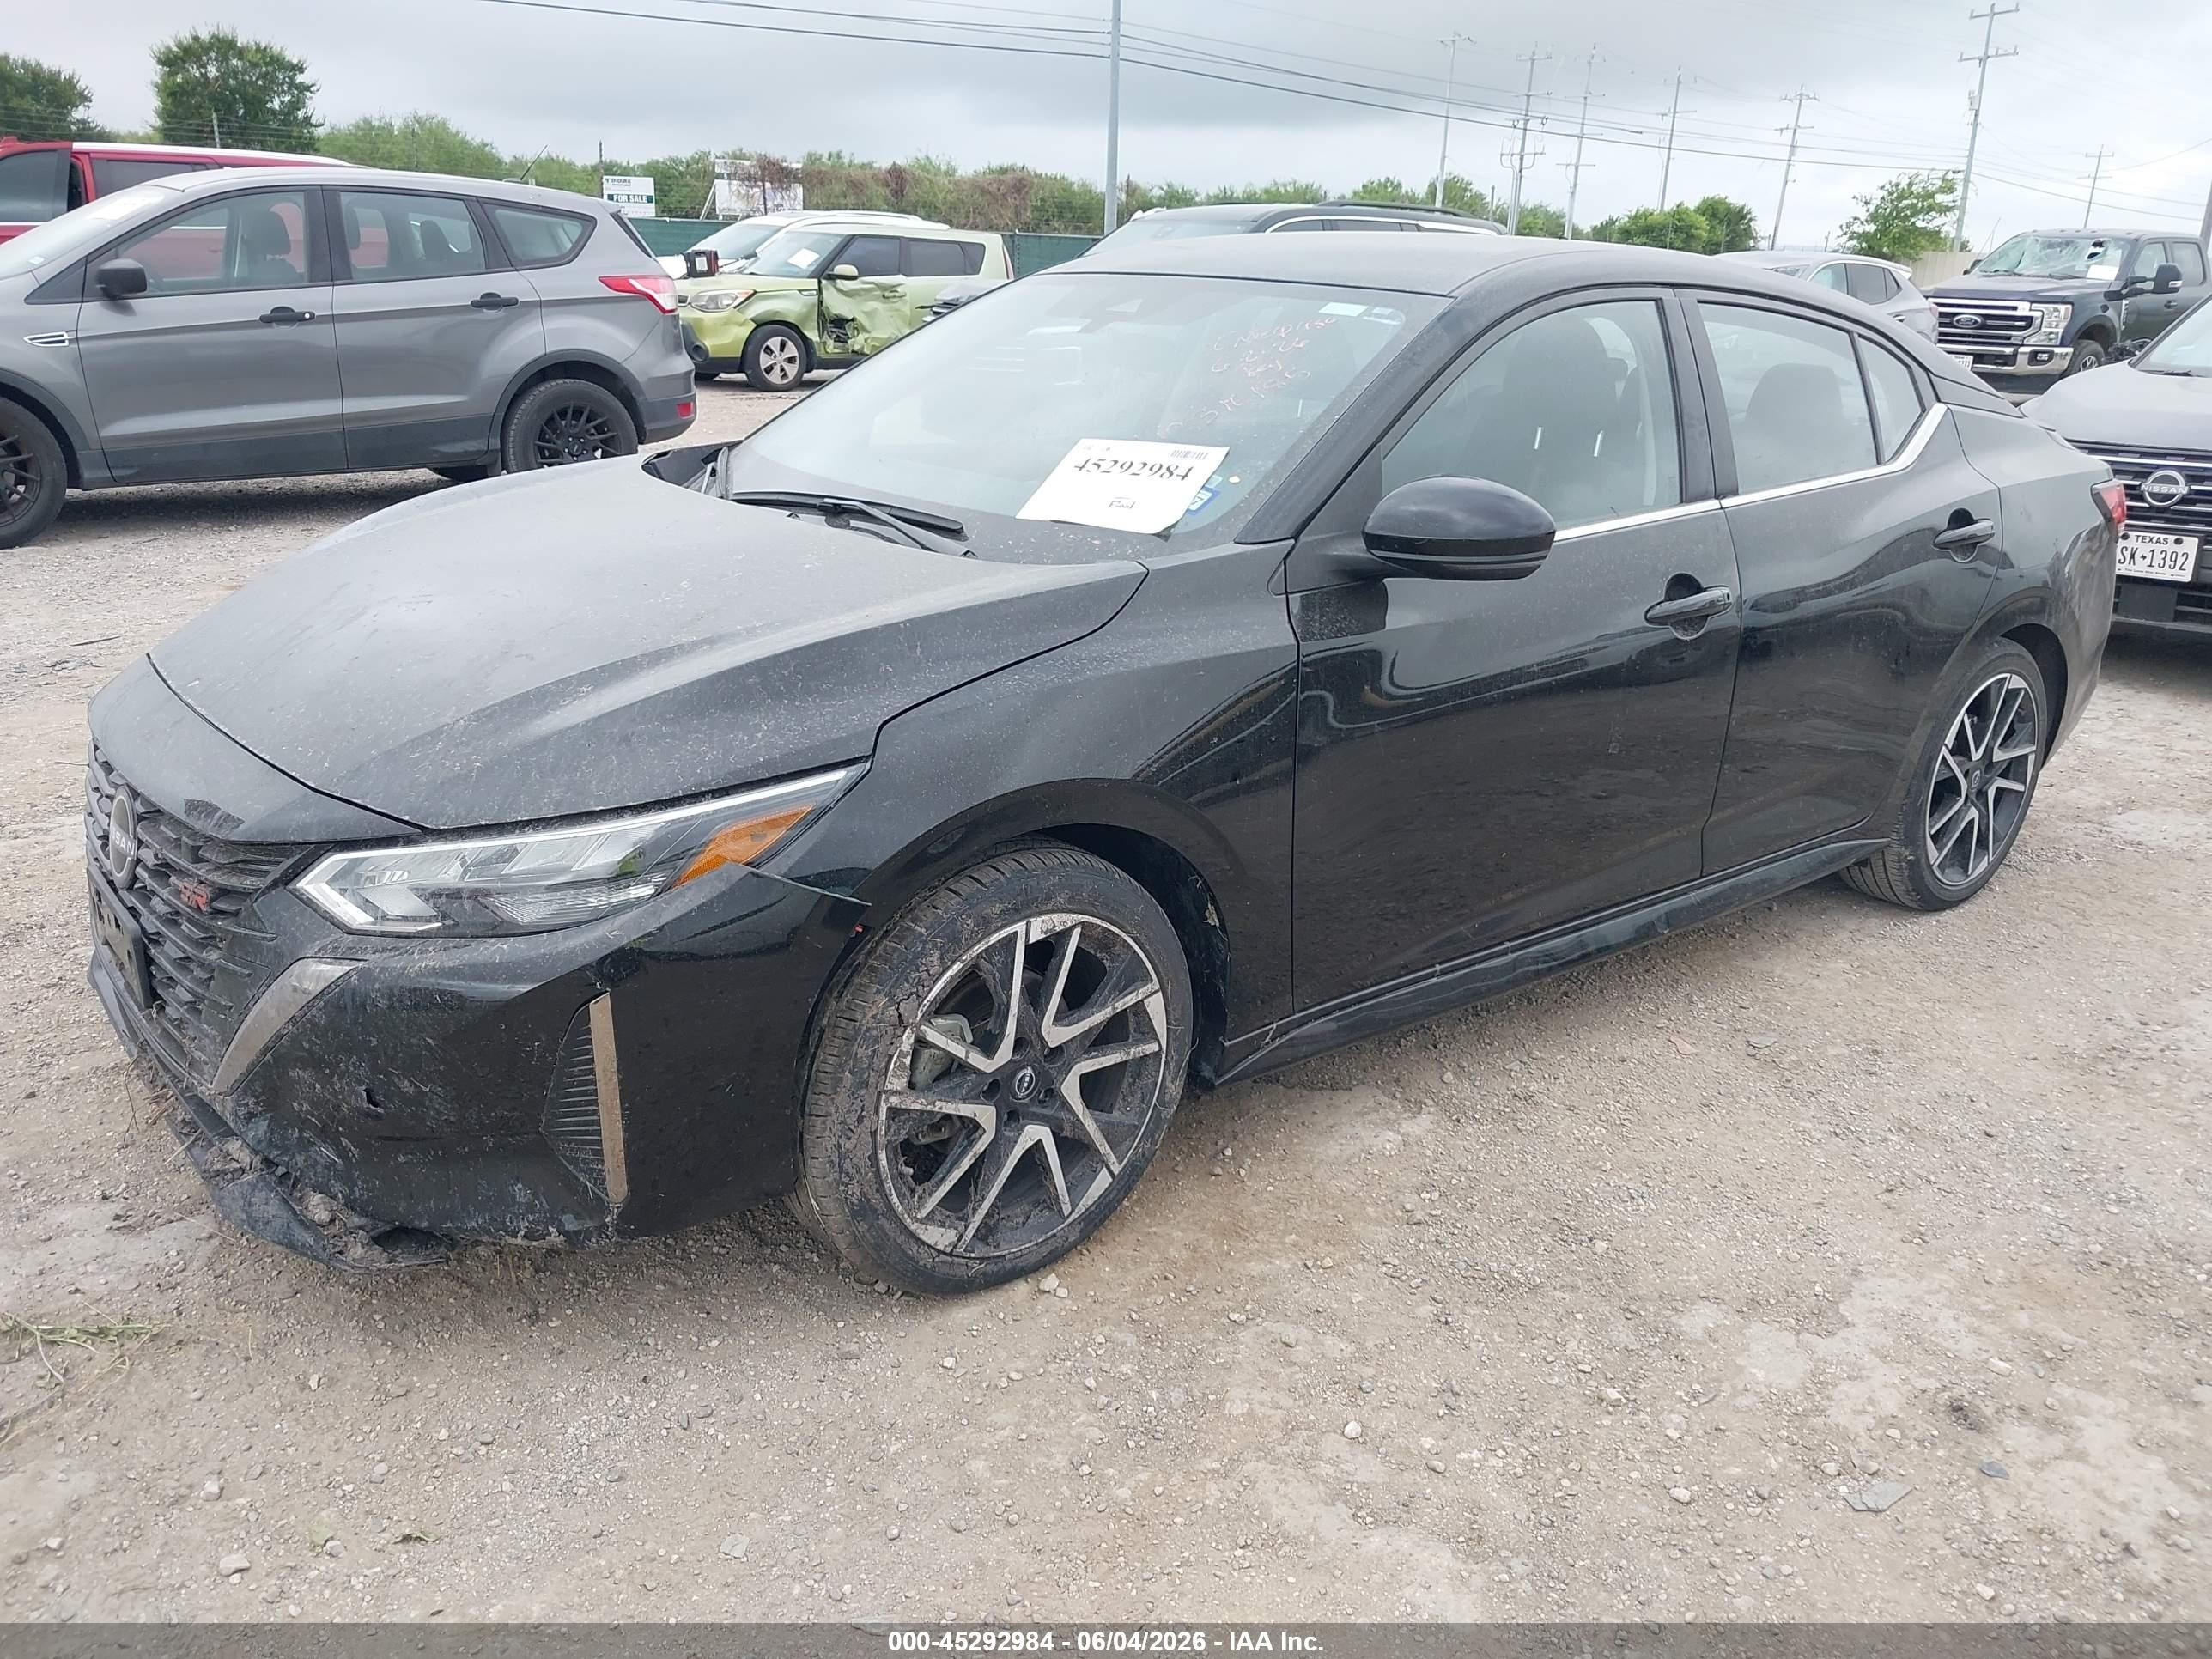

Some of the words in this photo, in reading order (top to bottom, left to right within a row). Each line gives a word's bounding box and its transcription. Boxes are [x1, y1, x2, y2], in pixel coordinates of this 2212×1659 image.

[613, 194, 629, 203] FOR
[629, 195, 647, 204] SALE
[1073, 458, 1194, 482] 45292984
[2140, 483, 2190, 495] NISSAN
[2134, 534, 2169, 545] TEXAS
